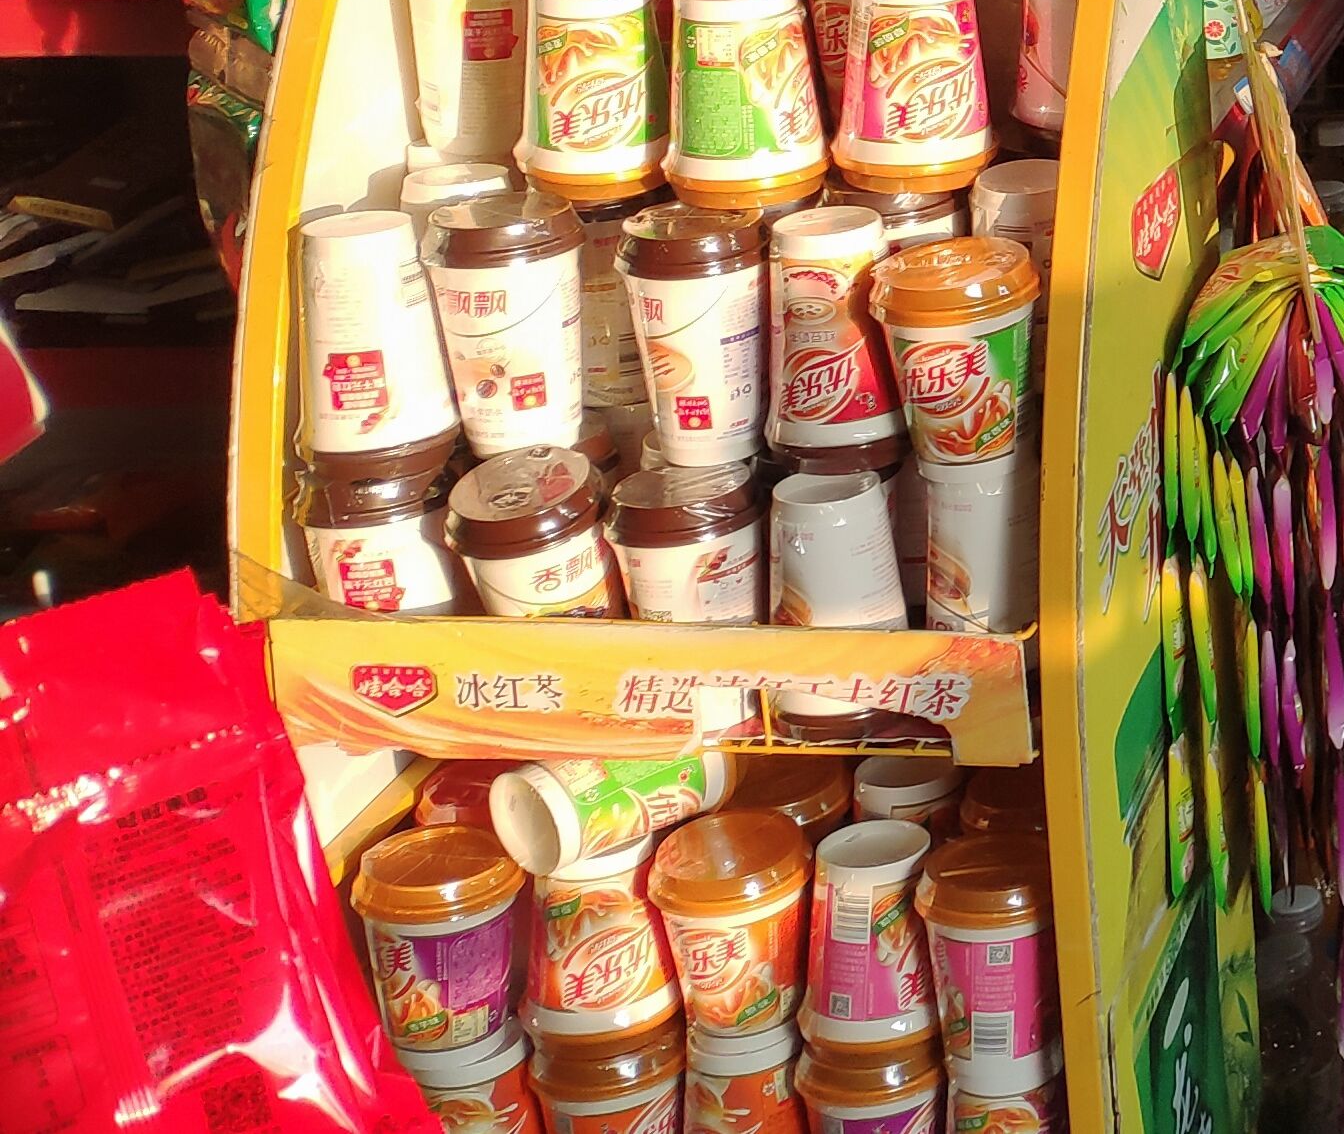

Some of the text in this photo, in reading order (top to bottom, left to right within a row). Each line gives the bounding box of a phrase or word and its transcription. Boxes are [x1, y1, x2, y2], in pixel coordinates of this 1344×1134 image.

[551, 79, 649, 143] 优乐美
[887, 68, 977, 136] 优乐美
[358, 675, 431, 698] 娃哈哈
[563, 936, 654, 1009] 优乐美
